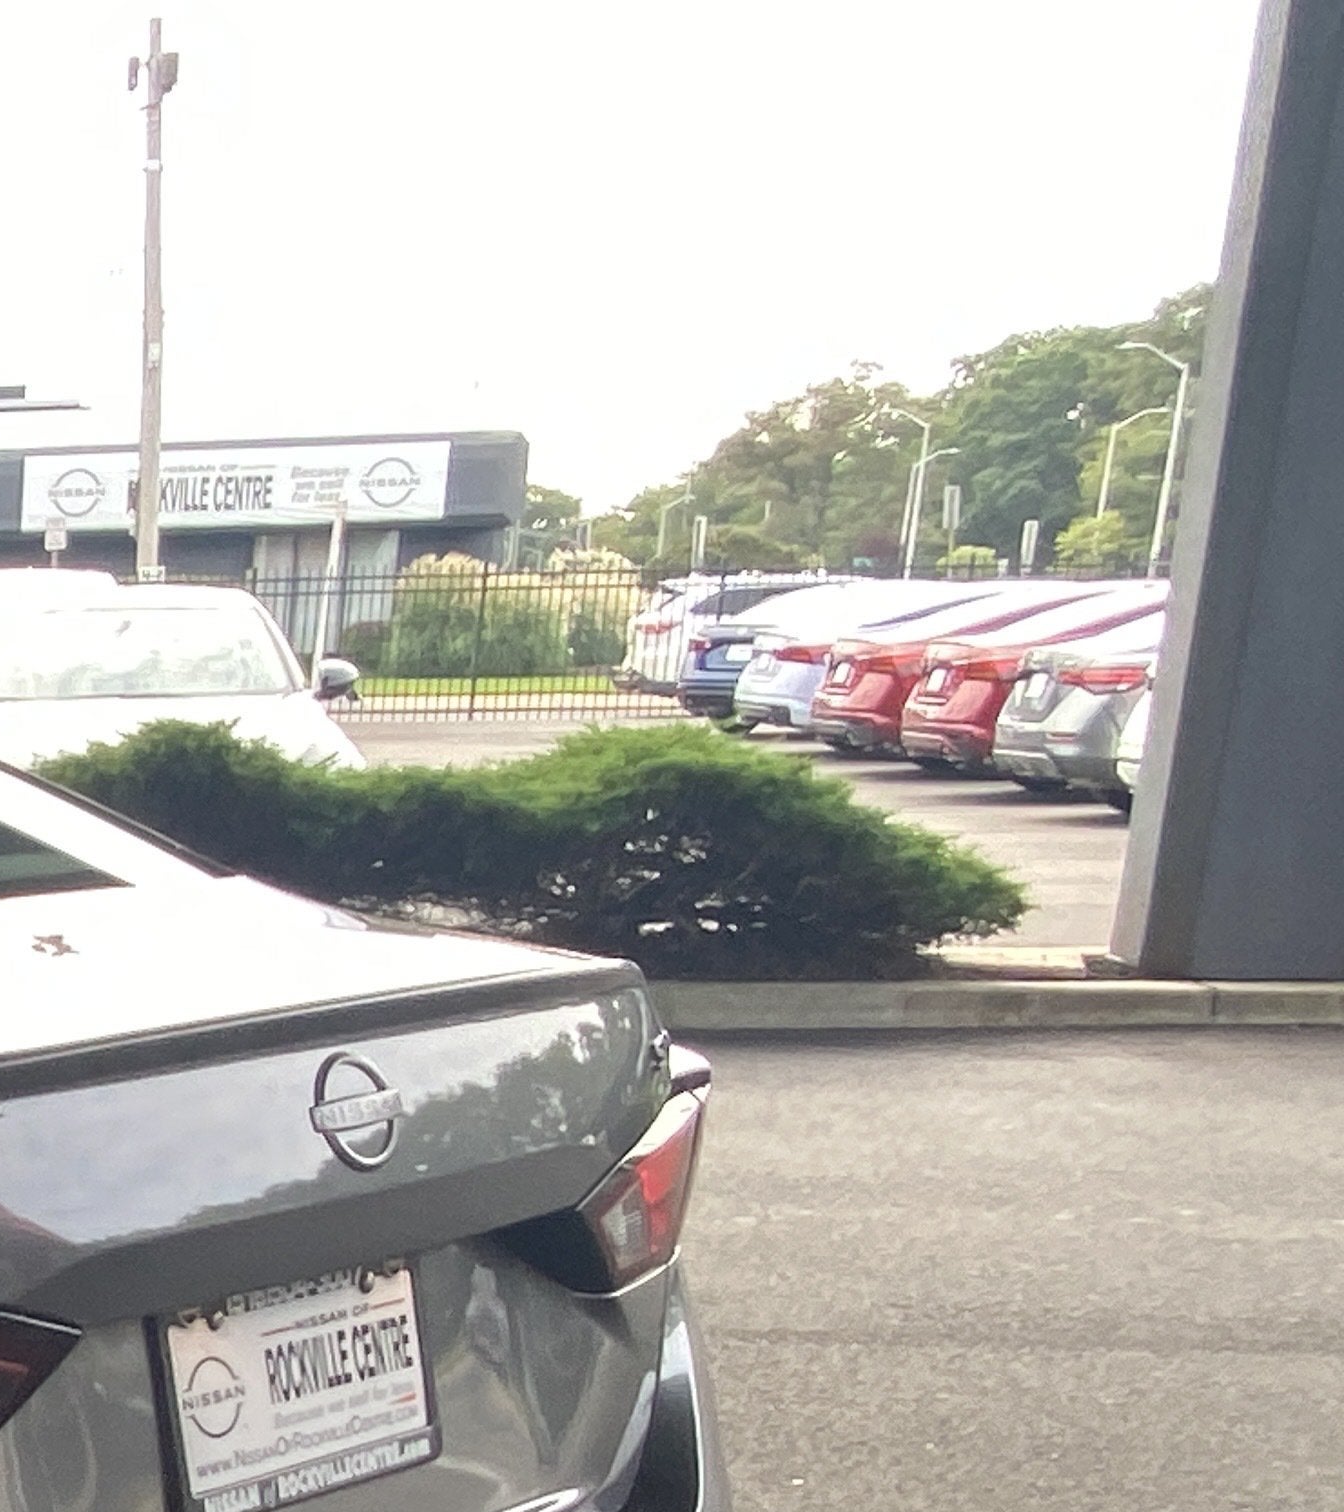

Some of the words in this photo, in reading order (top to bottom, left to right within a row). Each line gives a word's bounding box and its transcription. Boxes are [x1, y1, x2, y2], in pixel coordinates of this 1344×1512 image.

[48, 488, 105, 498] NISSAN
[127, 476, 210, 513] RKVILLE
[213, 475, 273, 511] CENTRE
[359, 478, 420, 487] NISSAN
[295, 1310, 347, 1328] NISSAN
[353, 1303, 369, 1317] OF
[265, 1330, 352, 1404] ROCKVILLE
[352, 1315, 413, 1381] CENTRE
[182, 1386, 245, 1411] NISSAN
